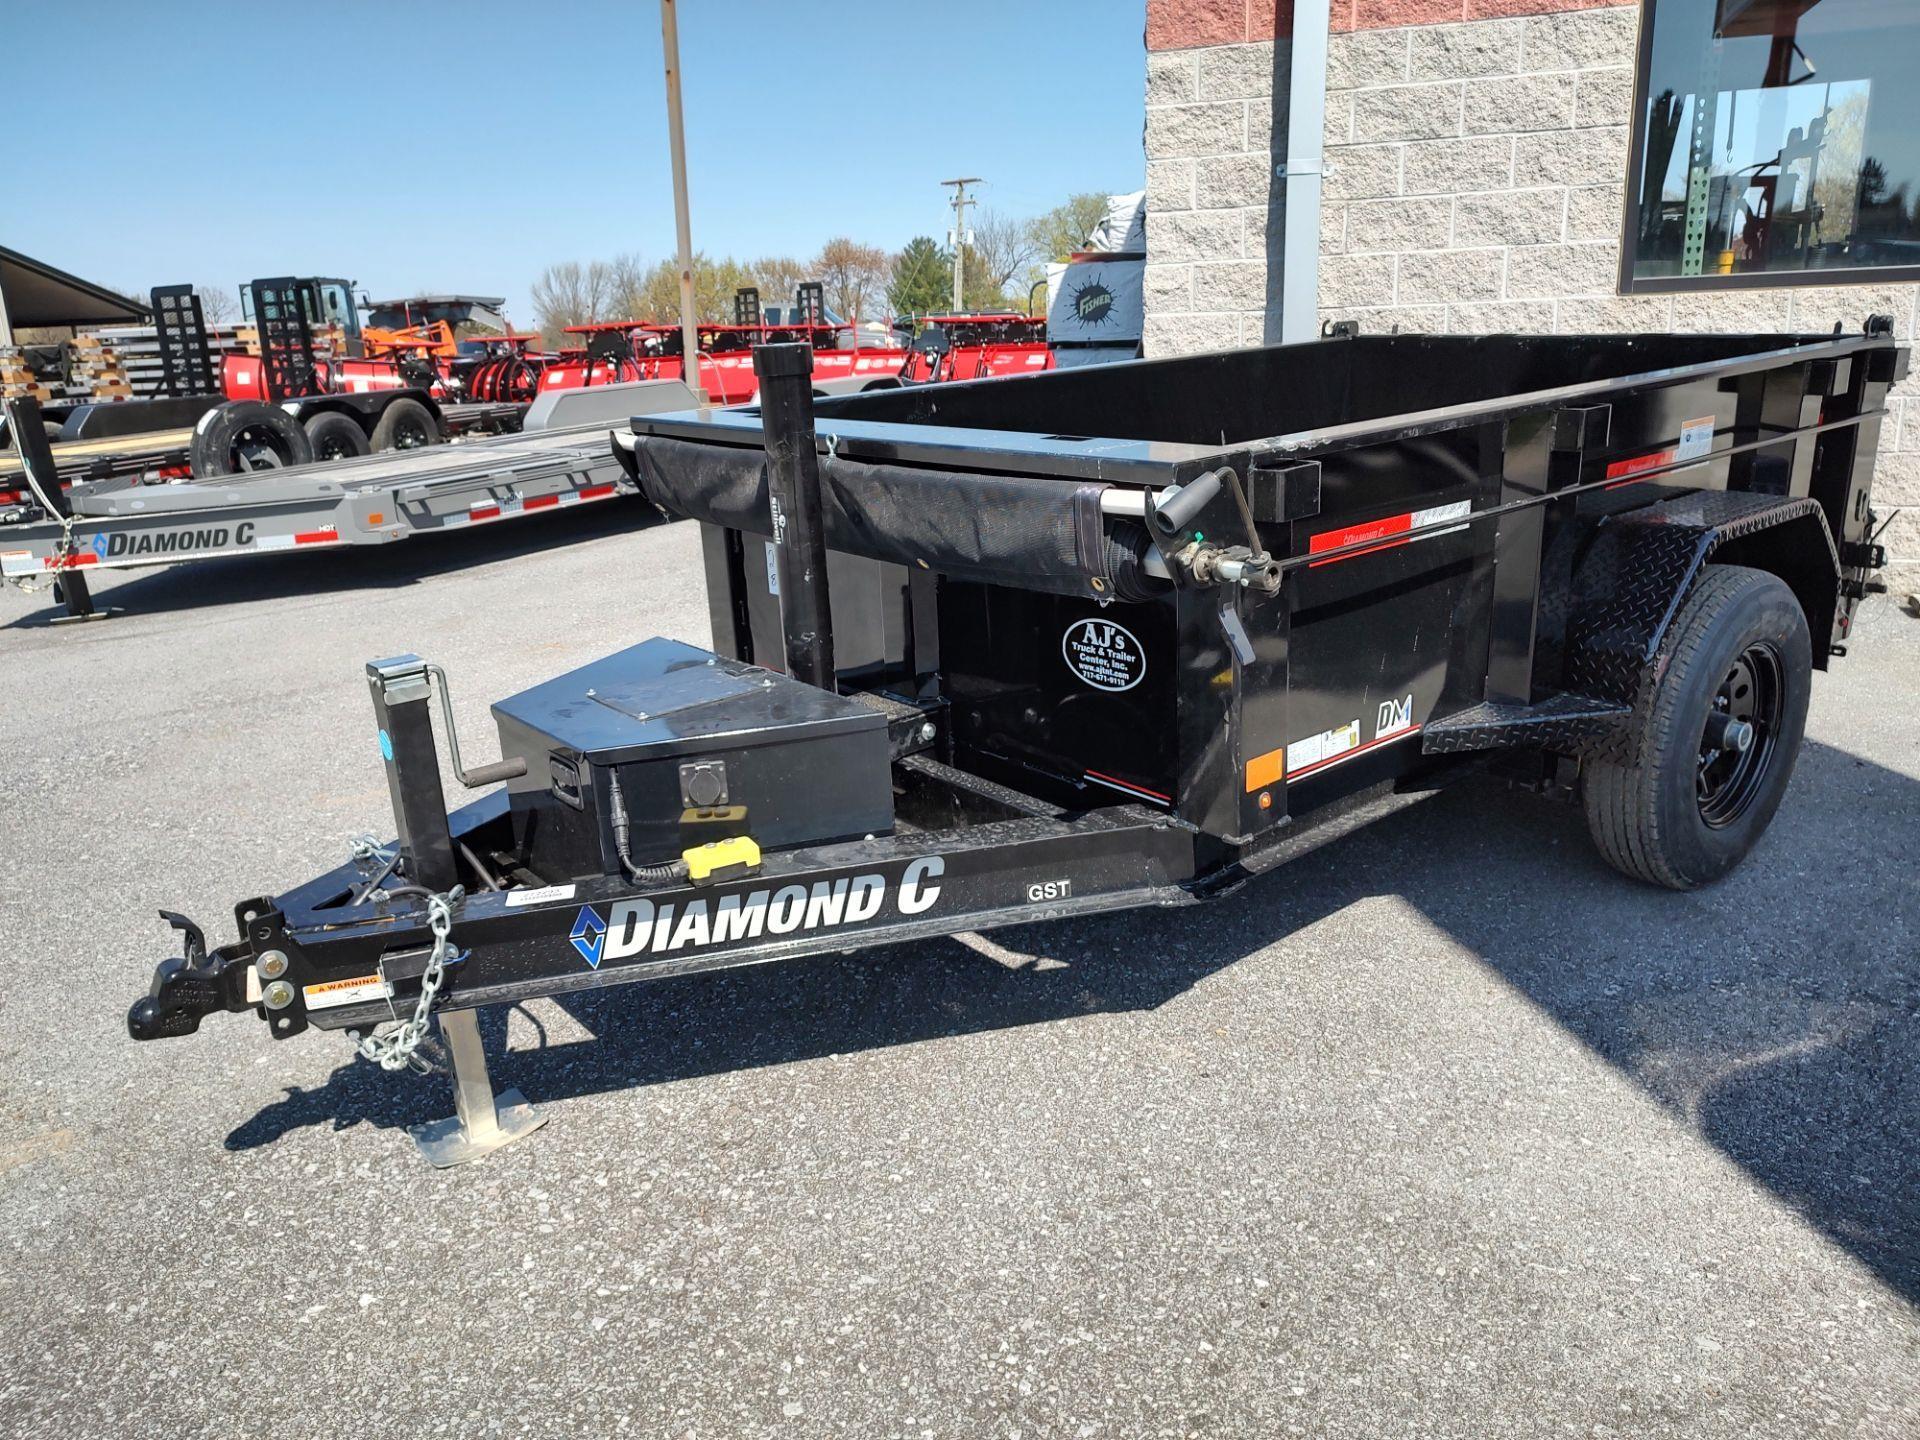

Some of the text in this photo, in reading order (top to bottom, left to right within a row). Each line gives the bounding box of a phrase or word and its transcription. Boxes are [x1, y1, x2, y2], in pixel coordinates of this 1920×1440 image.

[1079, 293, 1111, 318] FISHER
[107, 521, 255, 557] DIAMOND C
[1082, 623, 1125, 650] AJ's
[1071, 642, 1136, 663] Truck & Trailer
[1080, 653, 1128, 671] Center, Inc.
[1378, 696, 1411, 732] DM
[1028, 880, 1069, 902] GST
[602, 855, 945, 960] DIAMOND C
[326, 977, 378, 991] WARNING
